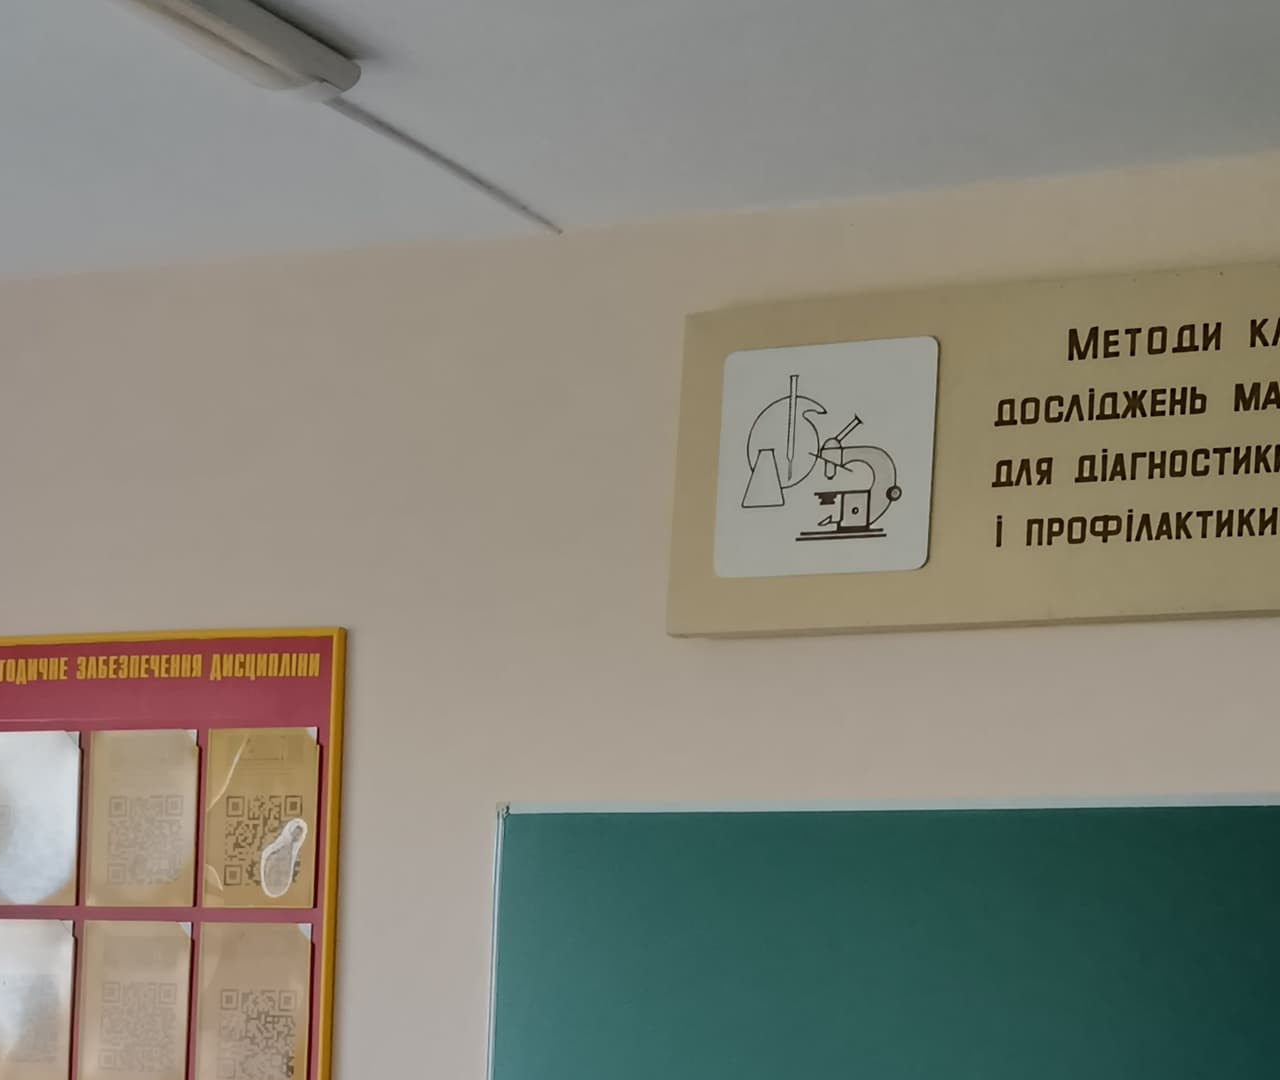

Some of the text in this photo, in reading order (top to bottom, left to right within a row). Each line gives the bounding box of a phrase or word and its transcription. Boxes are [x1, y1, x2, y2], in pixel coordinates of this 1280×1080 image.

[995, 387, 1207, 426] ДОСЛІДЖЕНЬ
[992, 457, 1053, 487] ДЛЯ
[1026, 507, 1278, 546] ПРОФІЛАКТИКИ
[77, 654, 202, 679] ЗАБЕЗПЕЧЕННЯ
[210, 653, 320, 680] ДИСЦИПЛІНИ
